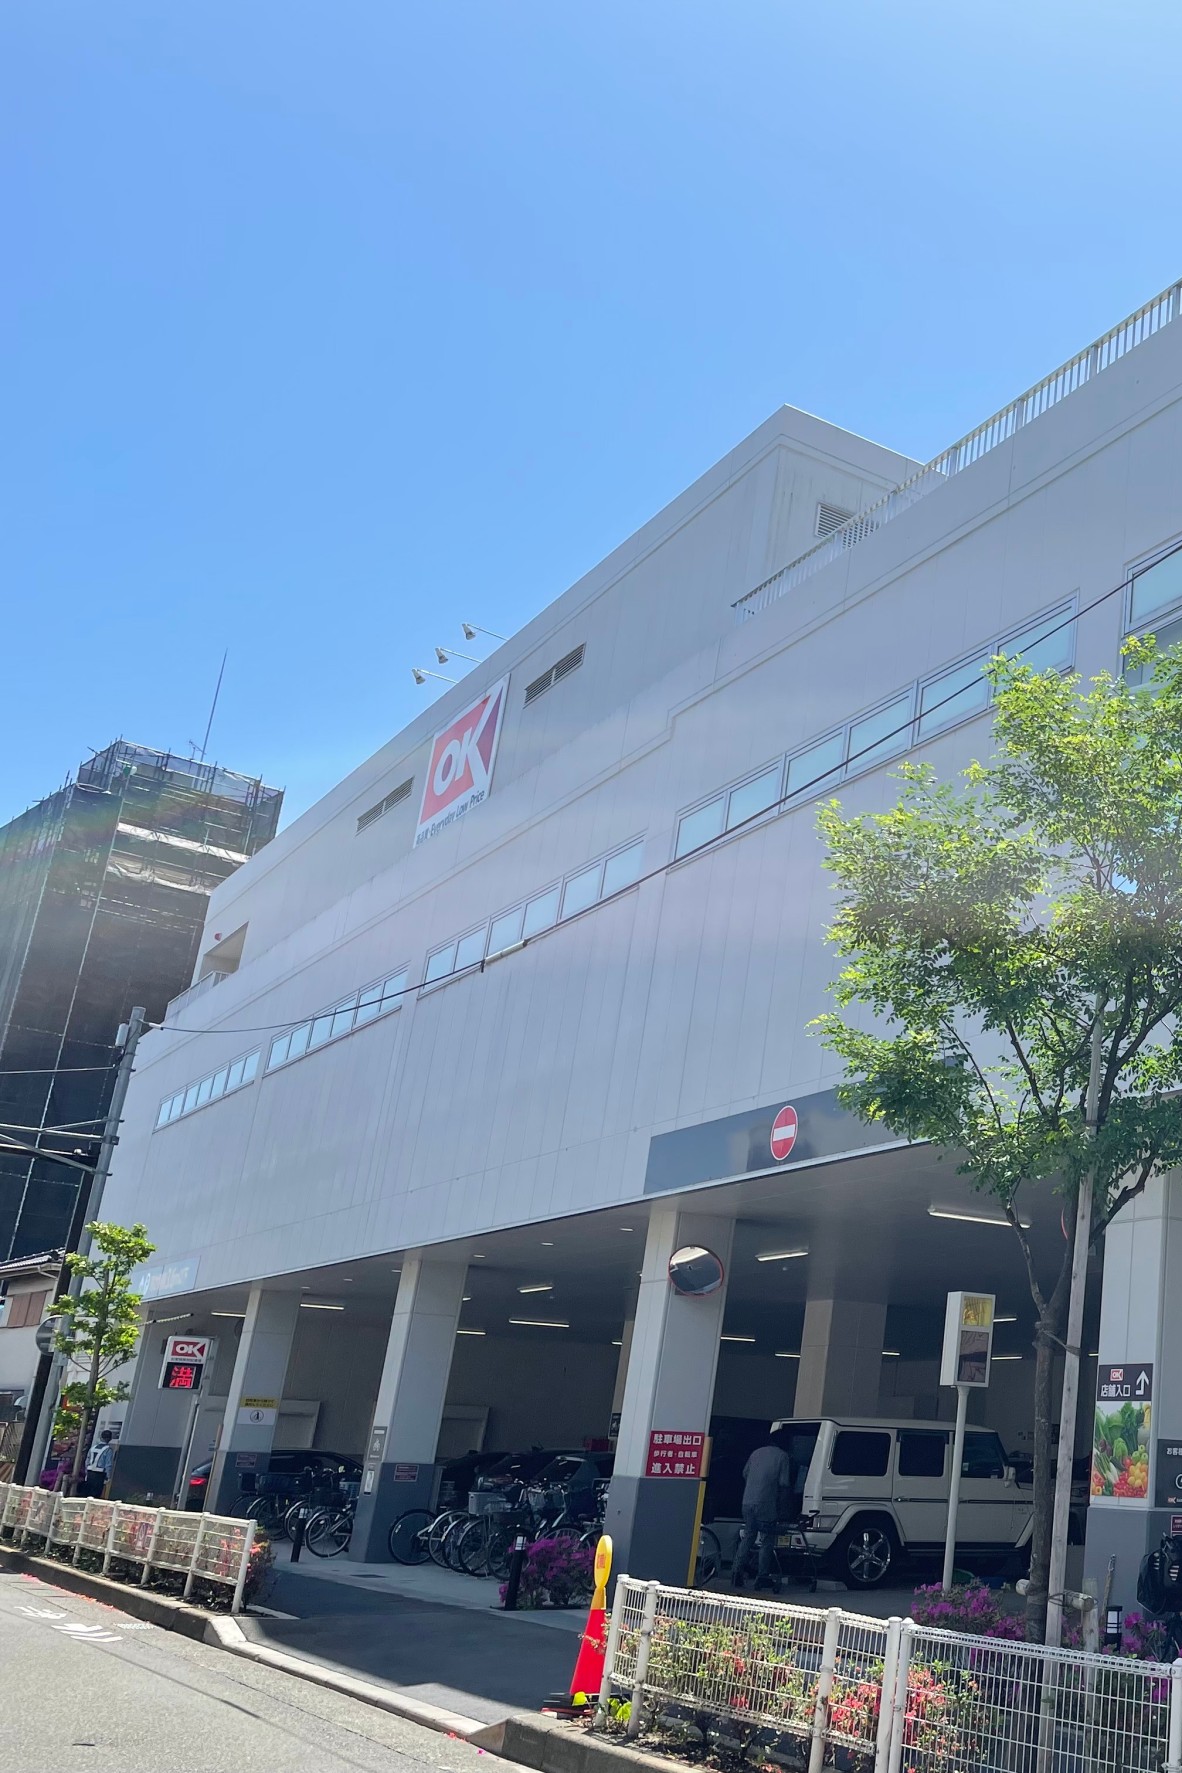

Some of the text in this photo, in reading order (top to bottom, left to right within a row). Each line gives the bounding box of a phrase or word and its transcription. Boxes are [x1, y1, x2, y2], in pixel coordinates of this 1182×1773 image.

[433, 687, 503, 796] OK
[456, 801, 469, 818] Low
[470, 790, 485, 808] Price
[175, 1342, 207, 1359] OK
[170, 1366, 193, 1387] 満
[1111, 1369, 1124, 1381] OK
[1101, 1385, 1130, 1397] 店舗入口
[653, 1433, 701, 1445] 駐車場出口
[651, 1462, 695, 1474] 進入禁止
